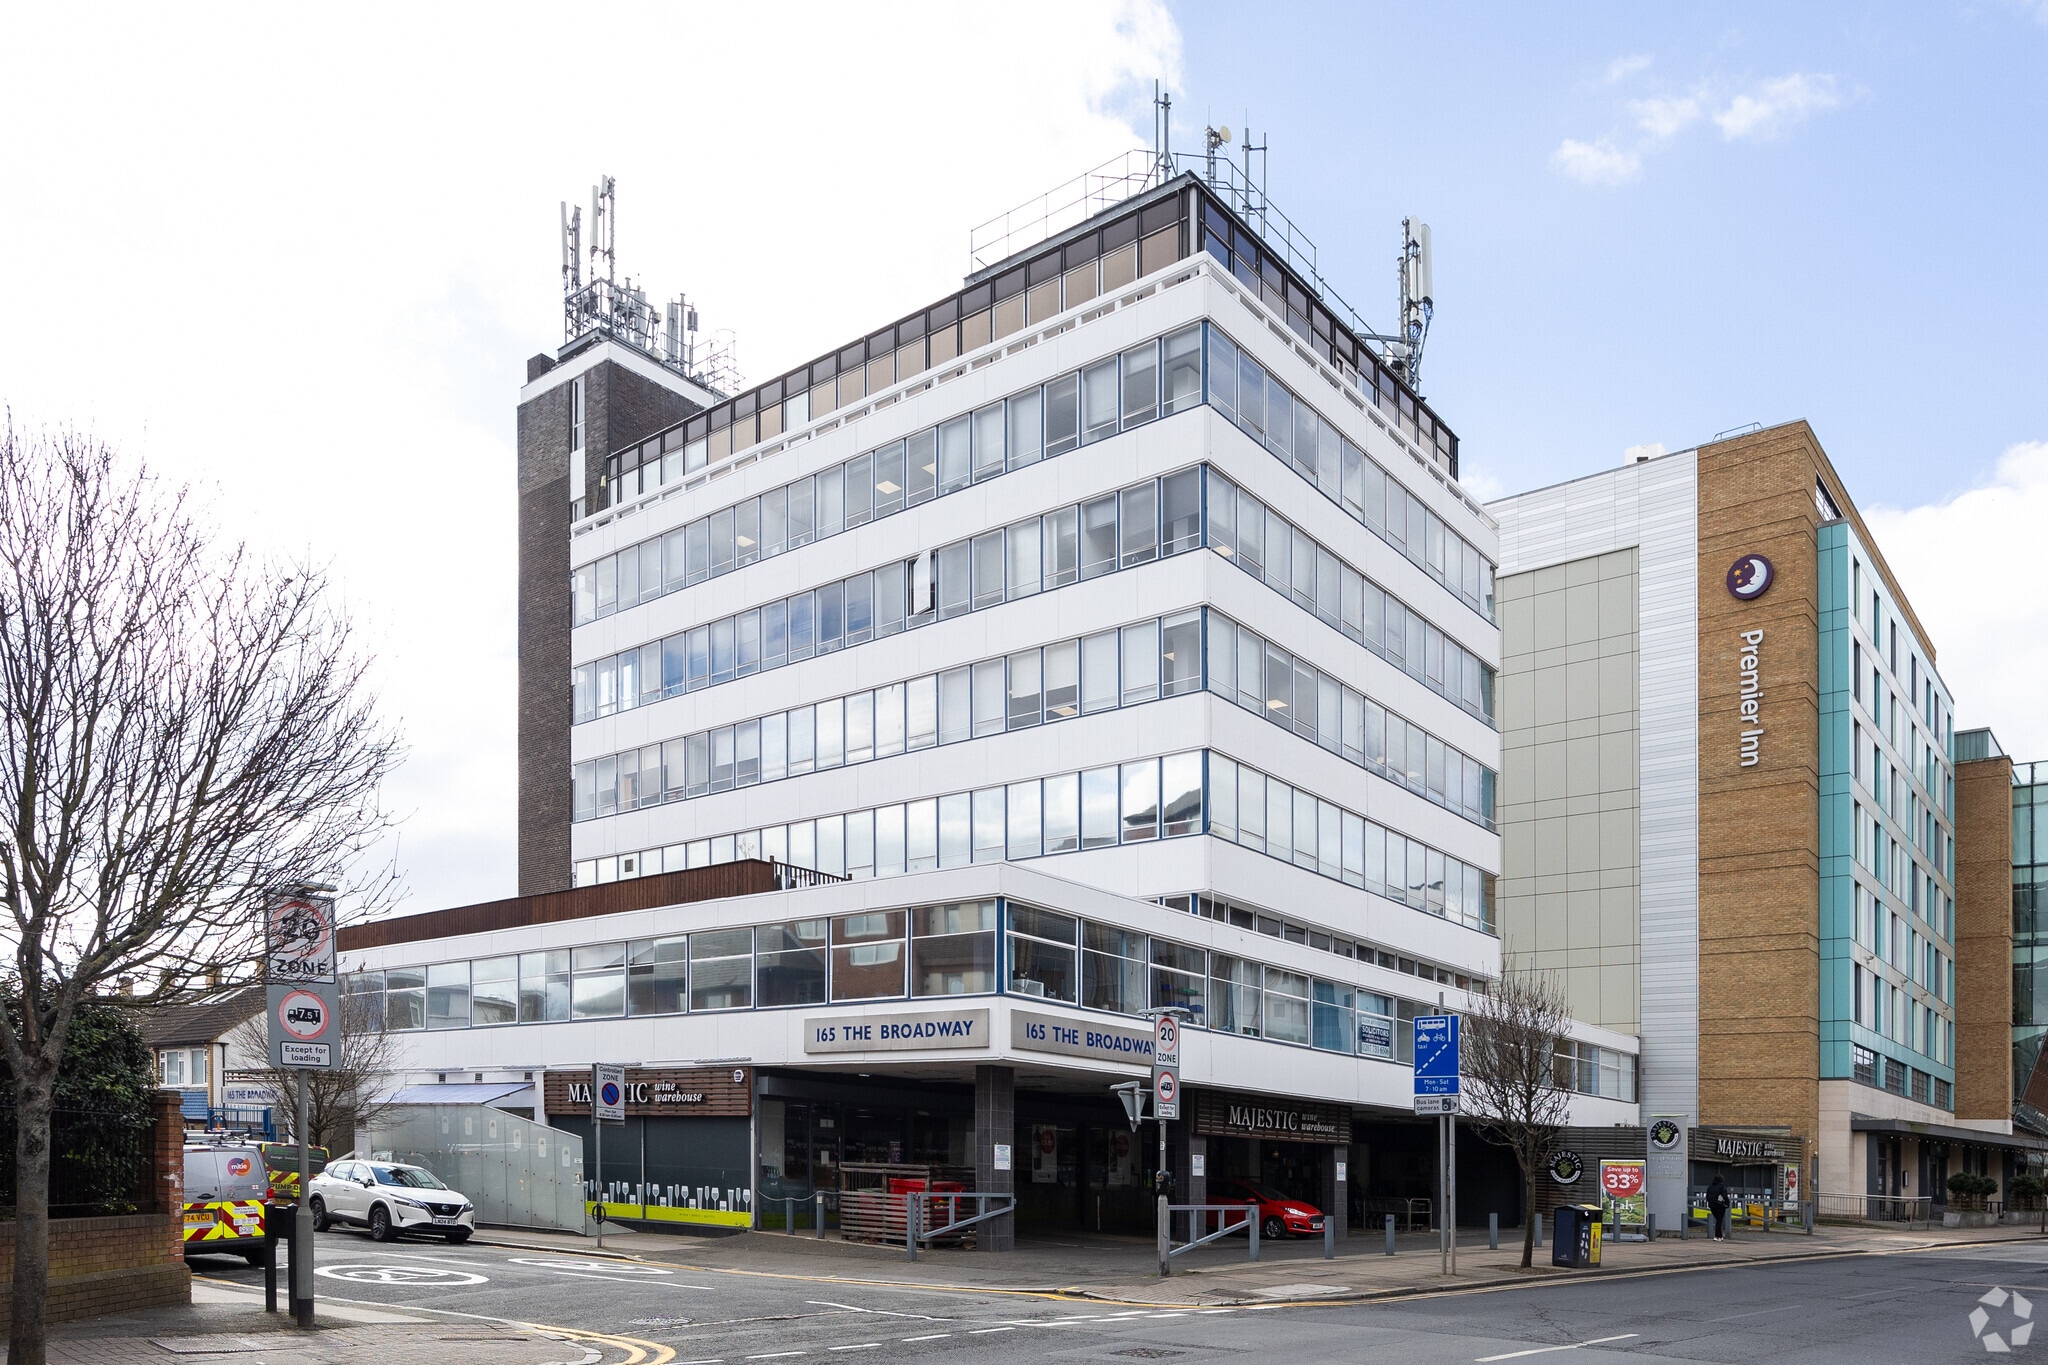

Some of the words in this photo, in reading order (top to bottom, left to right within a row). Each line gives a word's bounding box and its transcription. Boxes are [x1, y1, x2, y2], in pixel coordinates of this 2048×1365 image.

[1740, 629, 1764, 724] Premier
[1740, 729, 1764, 767] Inn
[816, 1027, 836, 1042] 165
[843, 1025, 872, 1040] THE
[881, 1020, 974, 1039] BROADWAY
[1026, 1022, 1046, 1040] 165
[1052, 1026, 1079, 1045] THE
[1160, 1027, 1174, 1041] 20
[1362, 1025, 1389, 1037] SOLICITORS
[285, 1045, 312, 1054] Except
[291, 1054, 320, 1063] loading
[1157, 1052, 1176, 1063] ZONE
[599, 1066, 622, 1074] Controlled
[654, 1081, 676, 1091] wine
[235, 1091, 245, 1099] THE
[654, 1091, 703, 1102] warehouse
[1229, 1105, 1298, 1131] MAJESTIC
[1302, 1112, 1317, 1121] wine
[1301, 1122, 1335, 1132] warehouse
[1717, 1139, 1762, 1157] MAJESTIC
[1550, 1151, 1582, 1168] MAJESTIC
[1606, 1174, 1639, 1189] 33%
[1611, 1200, 1636, 1213] Ialy
